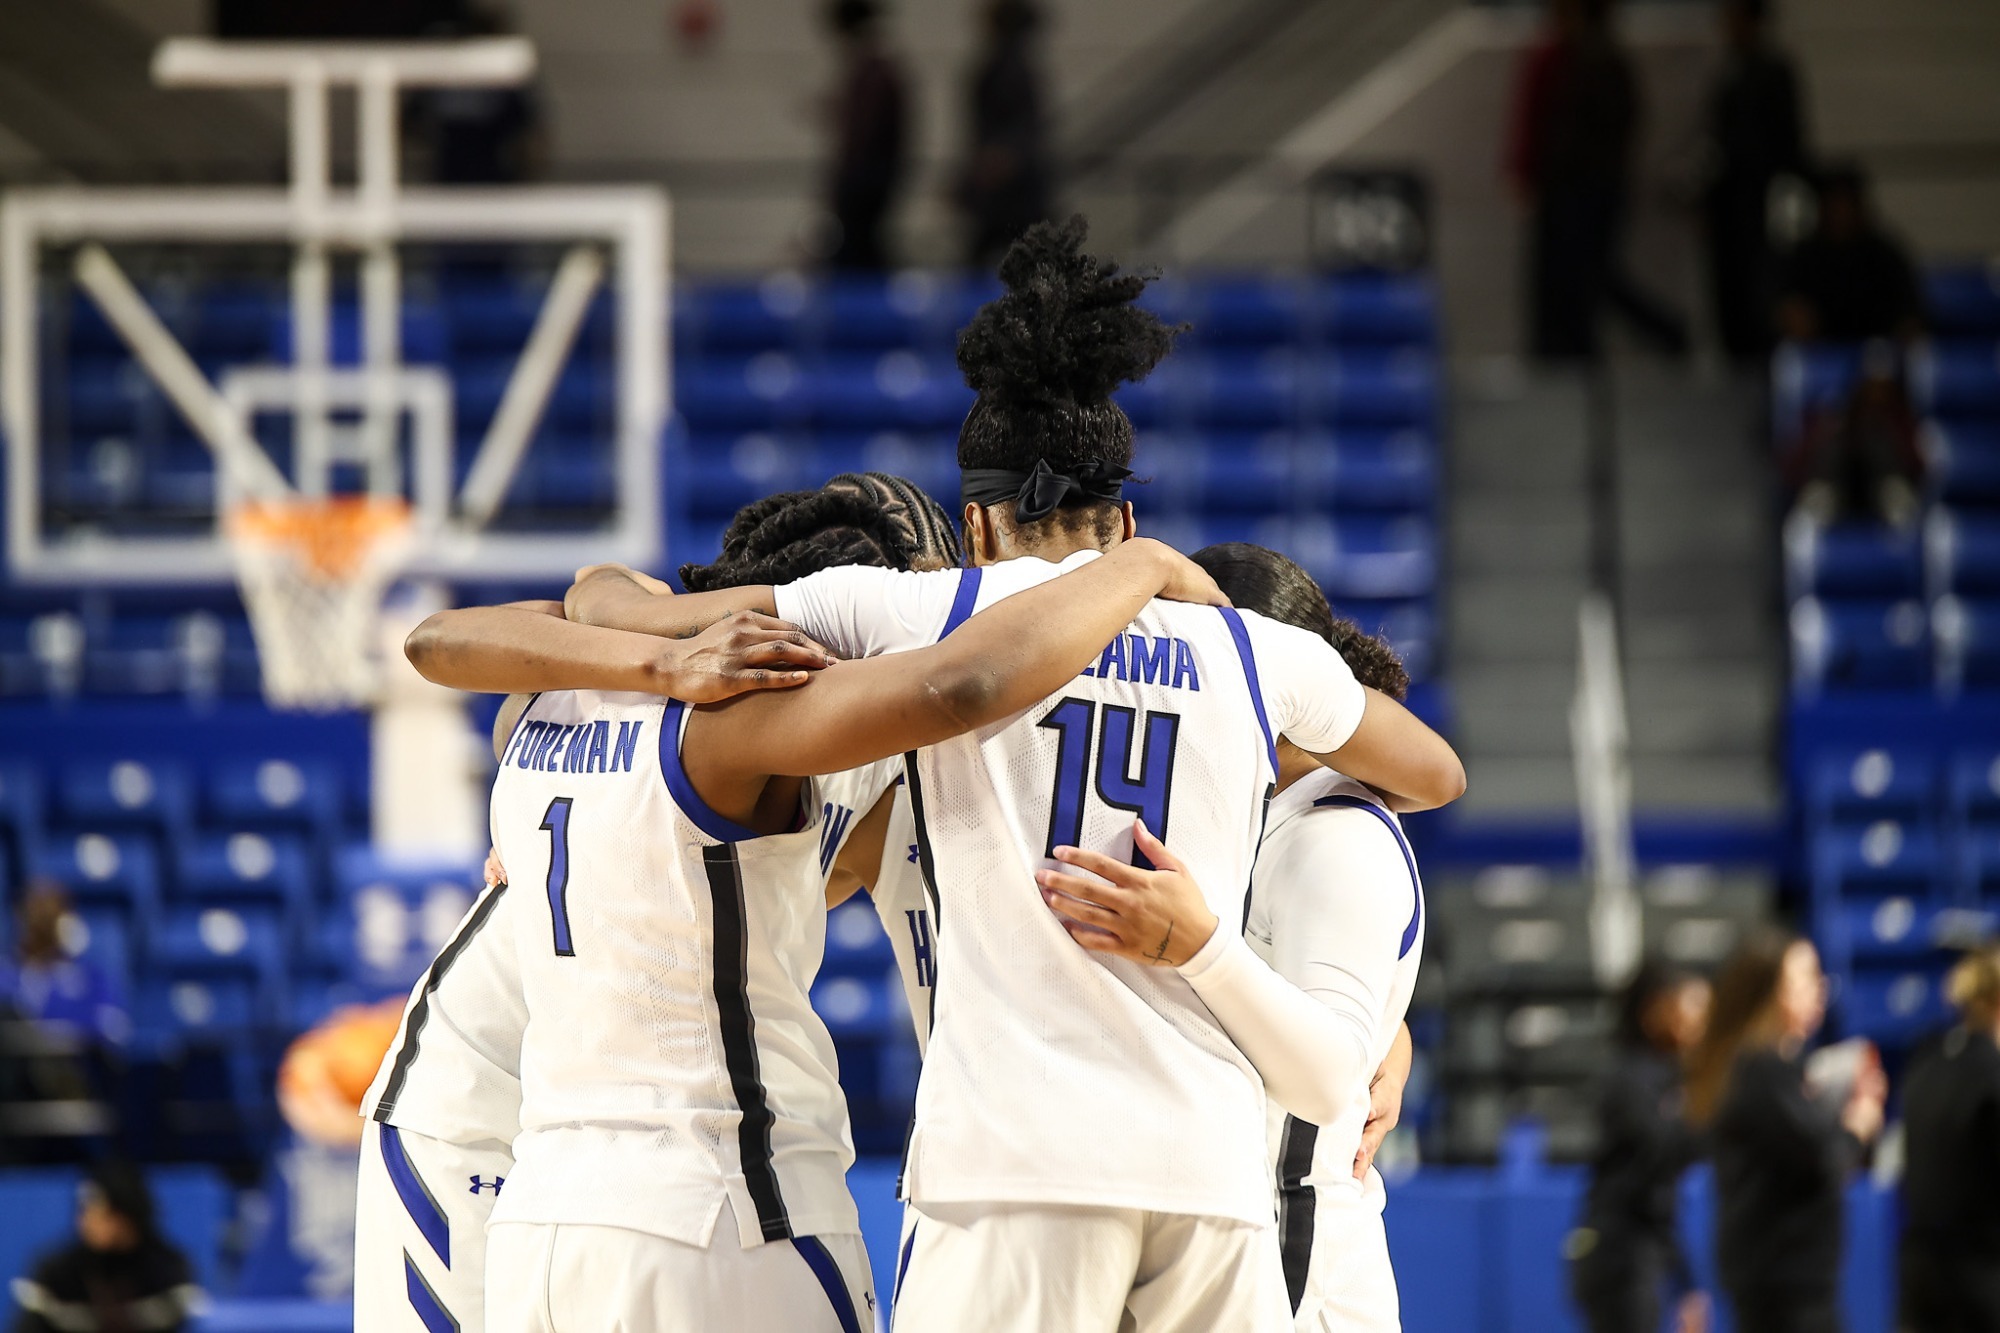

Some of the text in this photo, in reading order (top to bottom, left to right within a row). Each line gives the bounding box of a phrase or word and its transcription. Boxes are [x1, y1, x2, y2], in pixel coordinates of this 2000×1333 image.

[1081, 632, 1200, 692] AMA
[505, 719, 643, 773] FOREMAN
[1036, 696, 1180, 871] 14
[538, 796, 576, 957] 1
